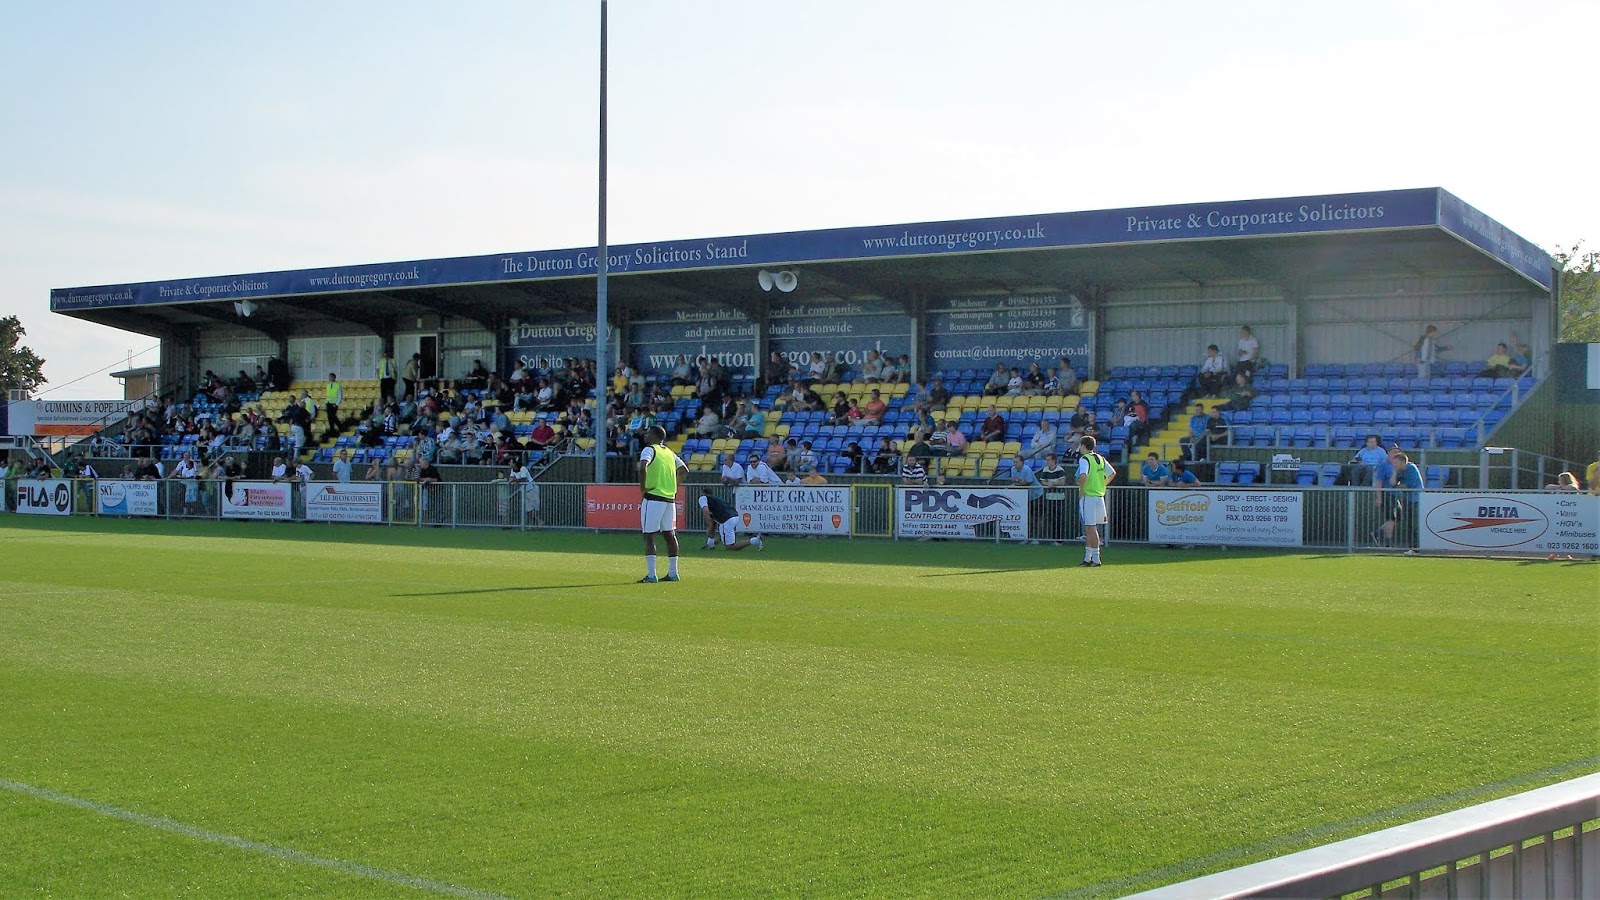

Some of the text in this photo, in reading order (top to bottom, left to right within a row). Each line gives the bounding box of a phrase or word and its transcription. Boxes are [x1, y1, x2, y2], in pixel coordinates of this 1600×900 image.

[1126, 203, 1385, 232] Private & Corporate Solicitors
[863, 222, 1046, 249] www.duttongregory.co.uk
[501, 239, 749, 274] The Dutton Greory Solicitors Stand
[309, 266, 420, 288] www.duttongregory.co.uk
[160, 280, 269, 298] Private & Corporate Solicitors
[677, 311, 714, 321] Meeting
[717, 309, 731, 319] the
[793, 306, 804, 315] of
[808, 304, 862, 319] companies
[520, 322, 613, 341] Dutton Gregy
[685, 328, 702, 338] and
[704, 326, 735, 340] private
[797, 322, 853, 334] nationwide
[950, 321, 994, 332] Bournemouth
[933, 344, 1090, 360] contact@duttongregory.co.uk
[45, 403, 82, 412] CUMMINS
[85, 403, 91, 412] &
[94, 403, 113, 412] POPE
[18, 486, 49, 507] FILA
[56, 489, 68, 506] JD
[100, 484, 114, 496] SKY
[753, 490, 842, 504] PETE GRANGE
[905, 490, 961, 513] PDC
[1155, 500, 1209, 515] Scaffold
[795, 514, 808, 522] 9271
[904, 512, 948, 520] CONTRACT
[949, 513, 1003, 521] DECORATORS
[1166, 514, 1204, 523] services
[1477, 506, 1519, 518] DELTA
